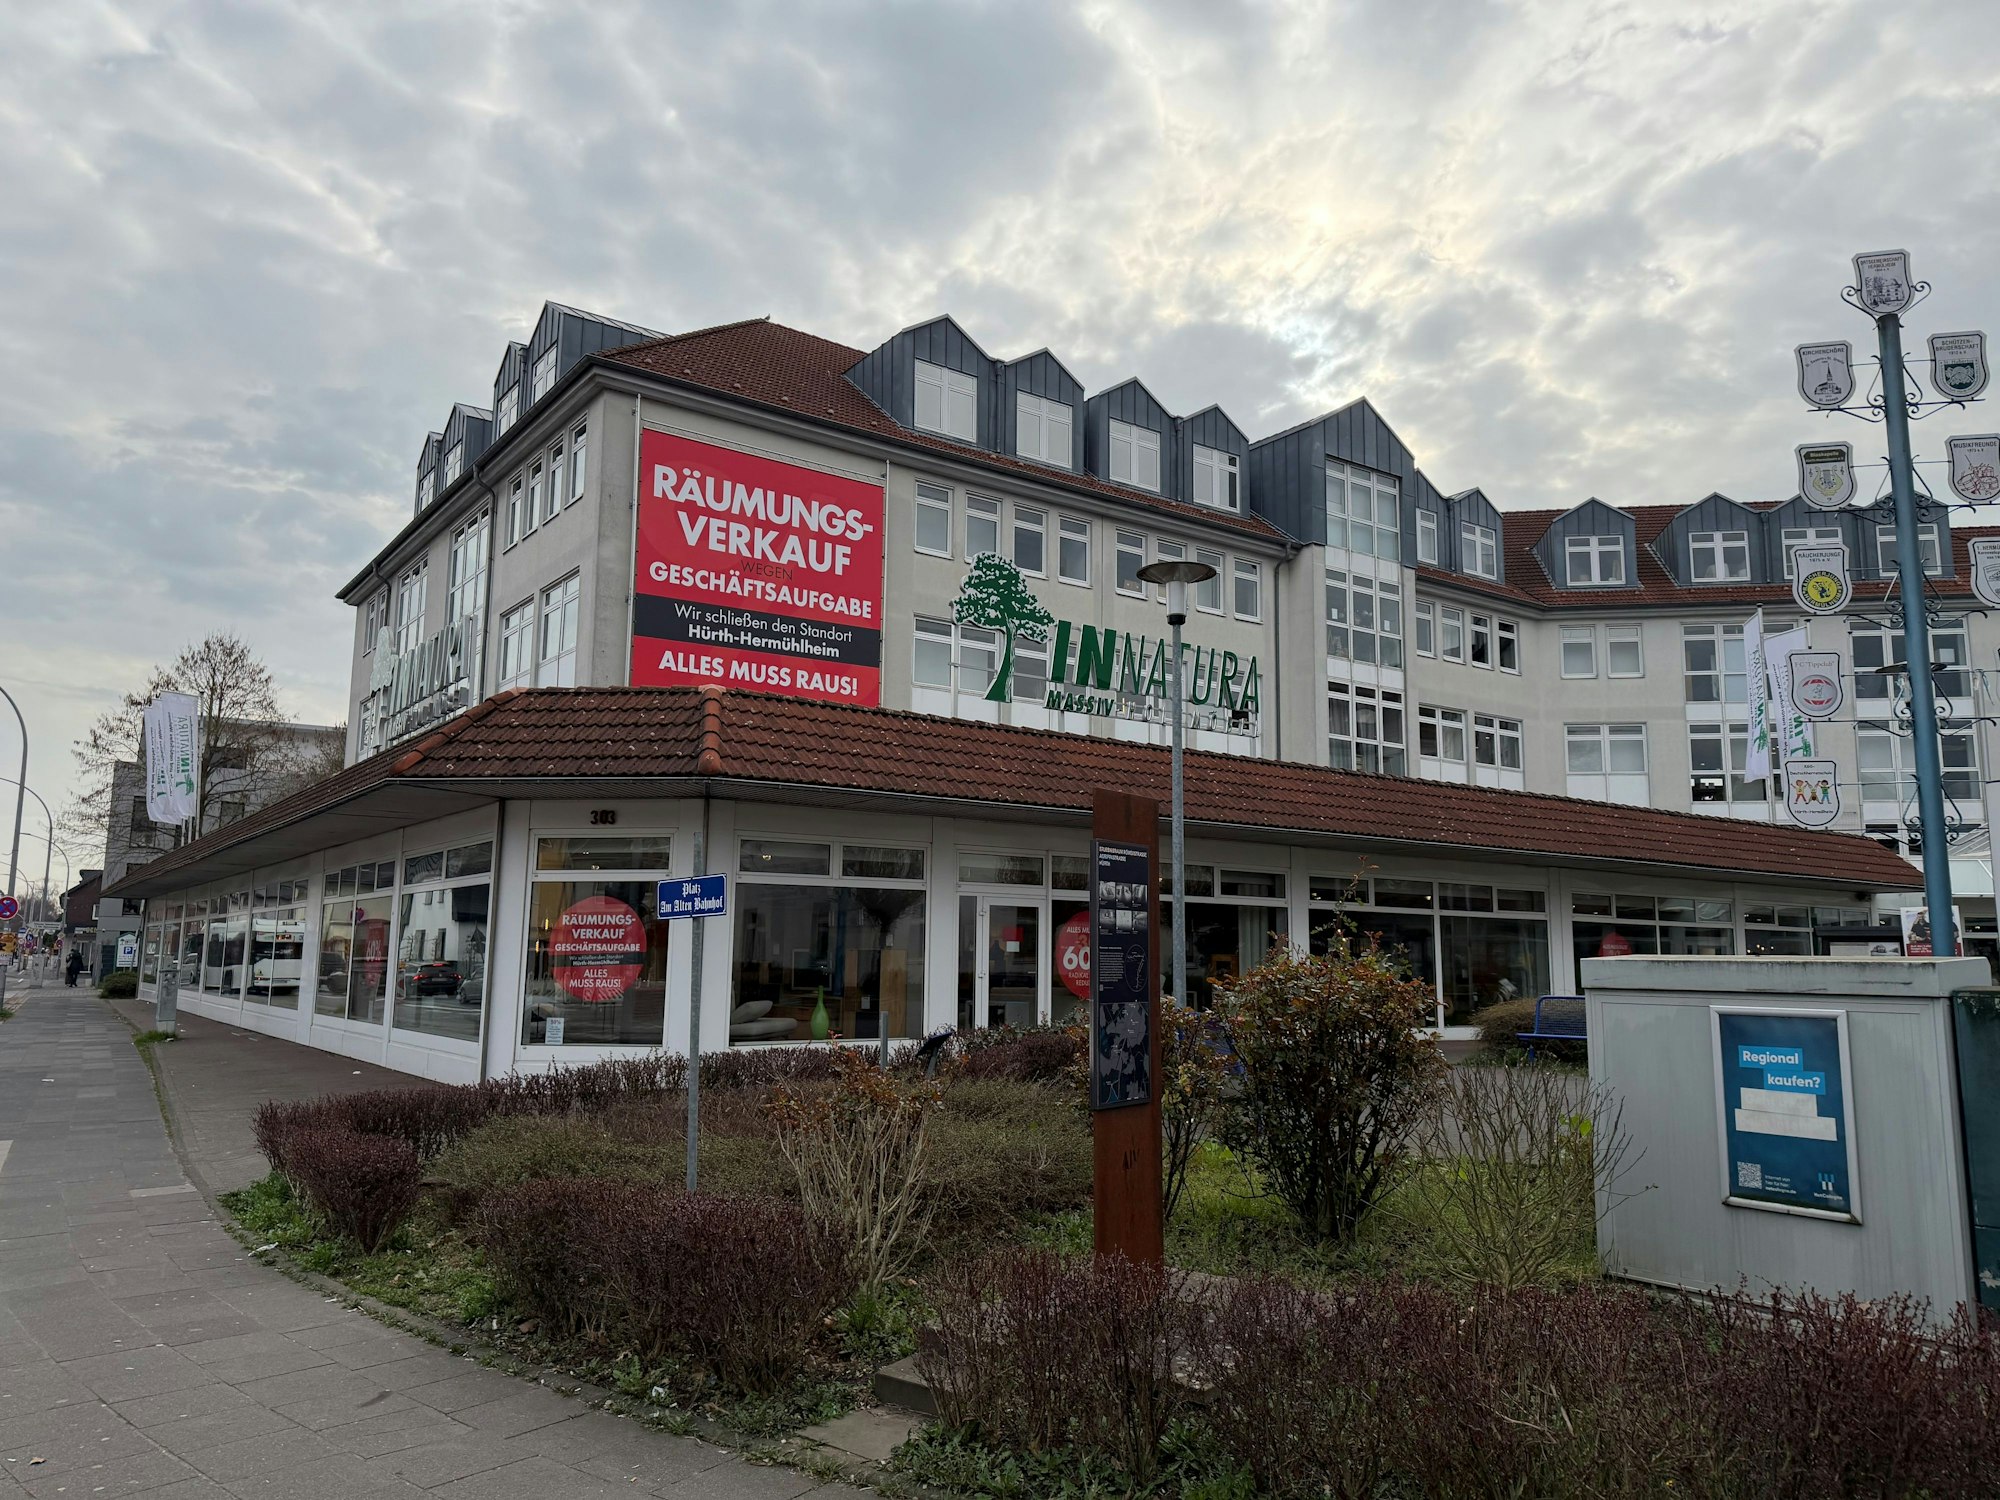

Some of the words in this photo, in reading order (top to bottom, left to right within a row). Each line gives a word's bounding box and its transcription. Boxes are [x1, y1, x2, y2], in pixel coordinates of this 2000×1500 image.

[1954, 441, 1997, 449] MUSIKFREUNDE
[653, 463, 873, 542] RÄUMUNGS-
[677, 511, 851, 575] VERKAUF
[740, 560, 793, 581] WEGEN
[650, 561, 872, 618] GESCHÄFTSAUFGABE
[674, 603, 701, 621] Wir
[705, 608, 768, 631] schließen
[771, 617, 796, 636] den
[800, 622, 853, 642] Standort
[688, 623, 840, 658] Hürth-Hermühlheim
[659, 650, 724, 678] ALLES
[729, 660, 791, 687] MUSS
[796, 670, 858, 696] RAUS!
[1046, 690, 1116, 717] MASSIV
[590, 810, 616, 825] 303
[682, 883, 701, 898] Platz
[660, 901, 672, 913] Am
[674, 900, 692, 912] Alten
[694, 895, 723, 912] Bahnhof
[562, 914, 636, 926] RÄUMUNGS-
[572, 928, 625, 940] VERKAUF
[1066, 926, 1081, 934] ALLES
[555, 941, 641, 952] GESCHÄFTSAUFGABE
[583, 969, 608, 978] ALLES
[569, 979, 594, 988] MUSS
[595, 978, 621, 988] RAUS!
[1742, 1050, 1799, 1065] Regional
[1767, 1073, 1821, 1088] kaufen?
